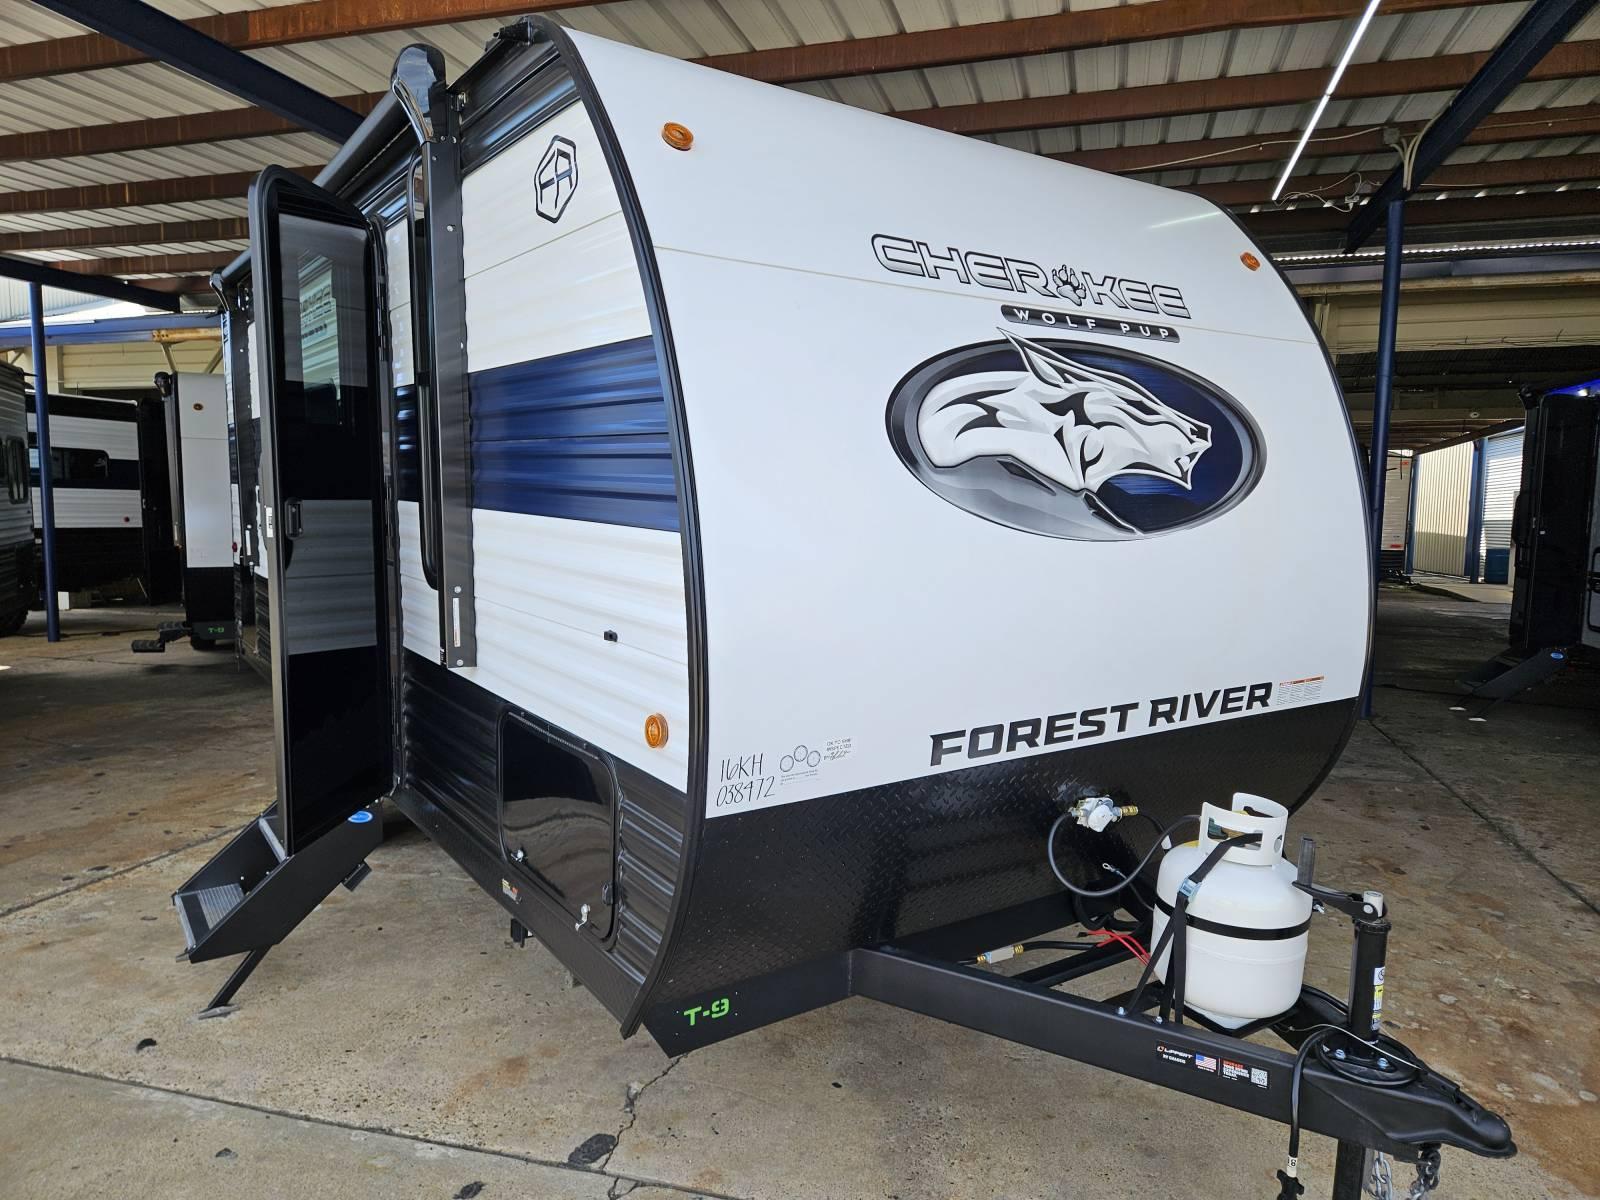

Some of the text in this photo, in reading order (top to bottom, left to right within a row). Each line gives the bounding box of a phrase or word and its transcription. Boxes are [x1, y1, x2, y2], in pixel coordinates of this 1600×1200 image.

[1013, 307, 1170, 340] WOLF PUP
[929, 702, 1140, 767] FOREST
[1147, 681, 1273, 727] RIVER
[683, 998, 730, 1026] T-9
